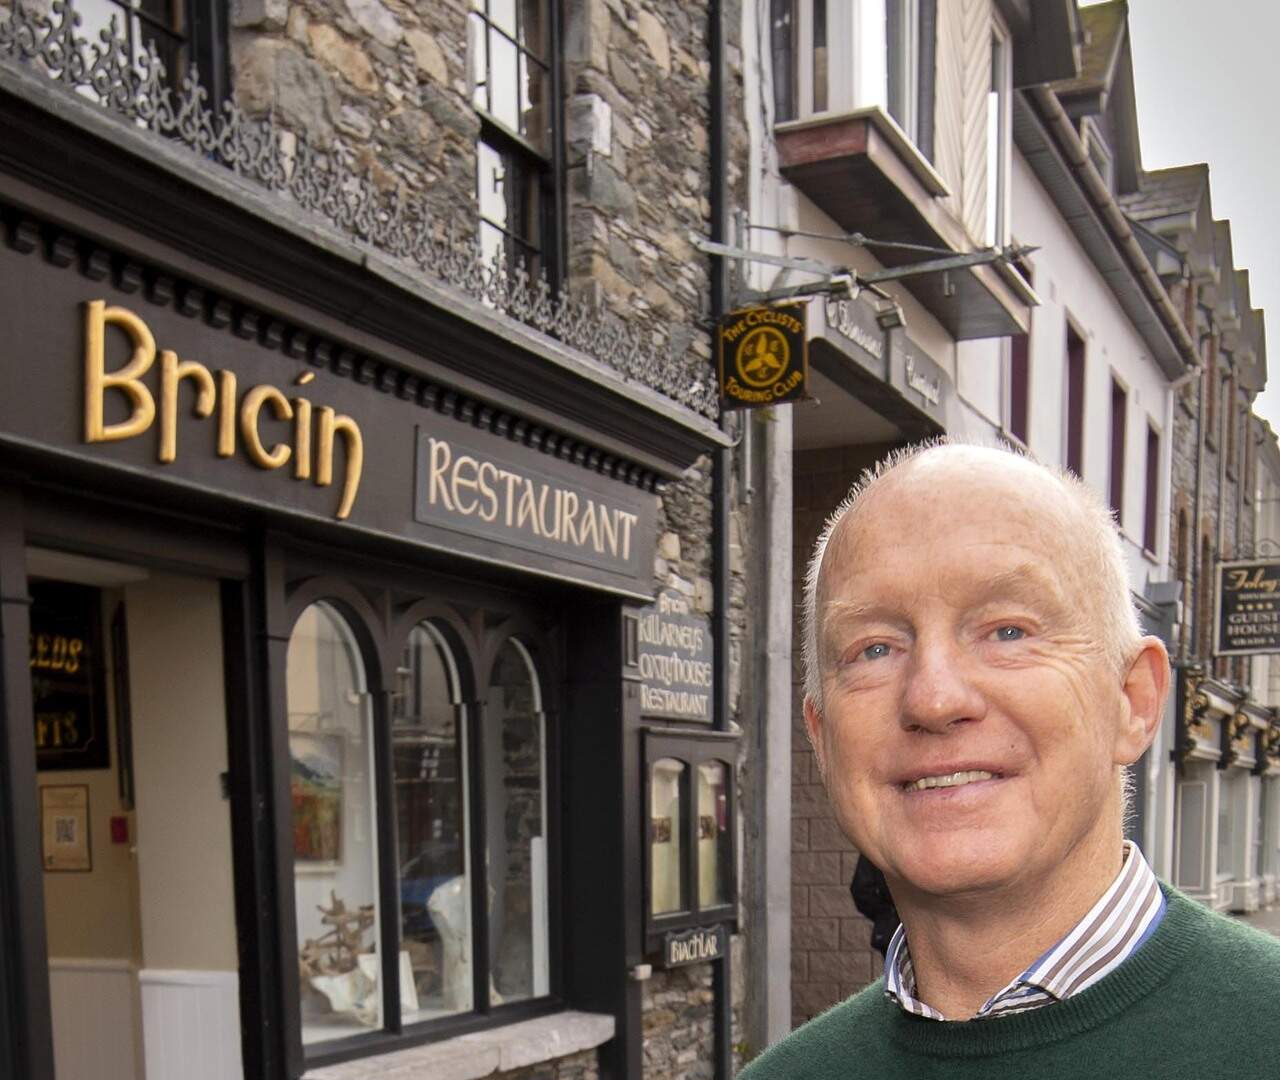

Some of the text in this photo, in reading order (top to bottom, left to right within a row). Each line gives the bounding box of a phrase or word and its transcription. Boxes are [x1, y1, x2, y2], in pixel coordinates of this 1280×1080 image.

[426, 435, 639, 562] RESTAURANT
[1228, 611, 1280, 624] GUEST
[1227, 623, 1280, 636] HOUSE
[640, 684, 709, 715] RESTAURANT
